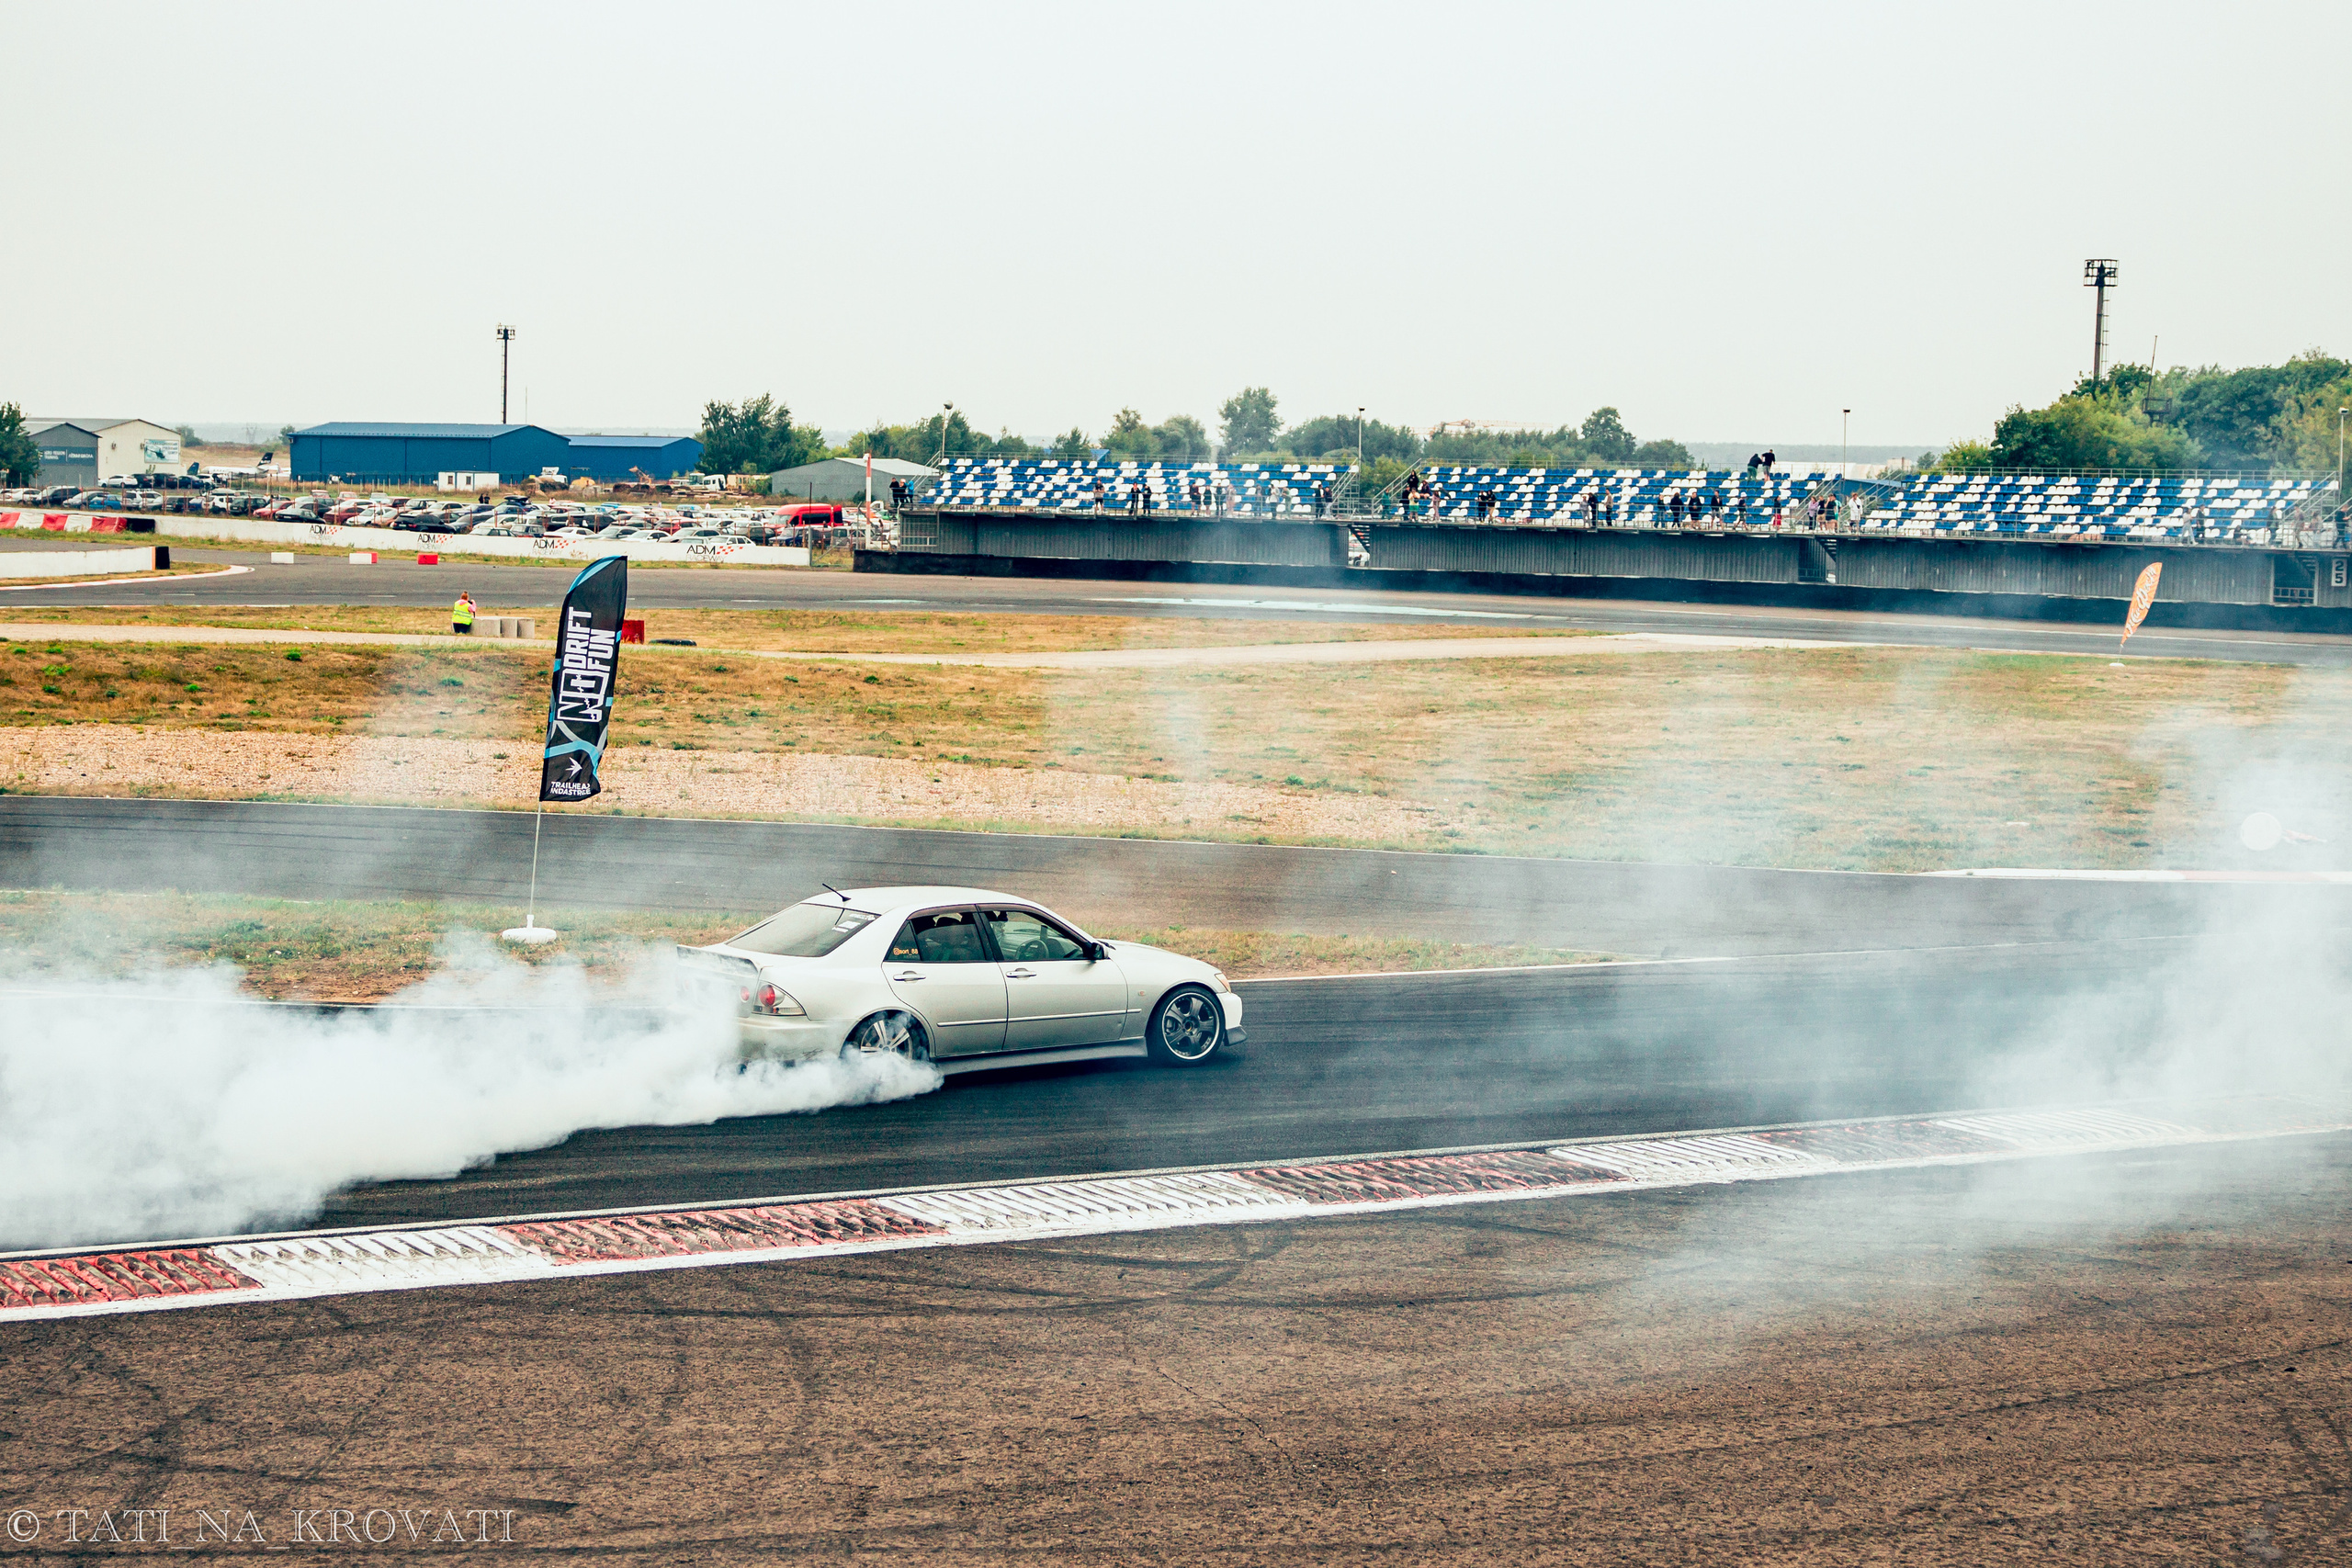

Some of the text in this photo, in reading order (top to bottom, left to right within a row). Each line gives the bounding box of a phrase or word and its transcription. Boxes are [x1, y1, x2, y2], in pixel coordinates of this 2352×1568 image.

[309, 525, 327, 535] ADM
[417, 534, 435, 543] ADM
[533, 539, 555, 549] ADM
[686, 545, 716, 555] ADM
[563, 606, 592, 669] DRIFT
[587, 628, 616, 671] FUN
